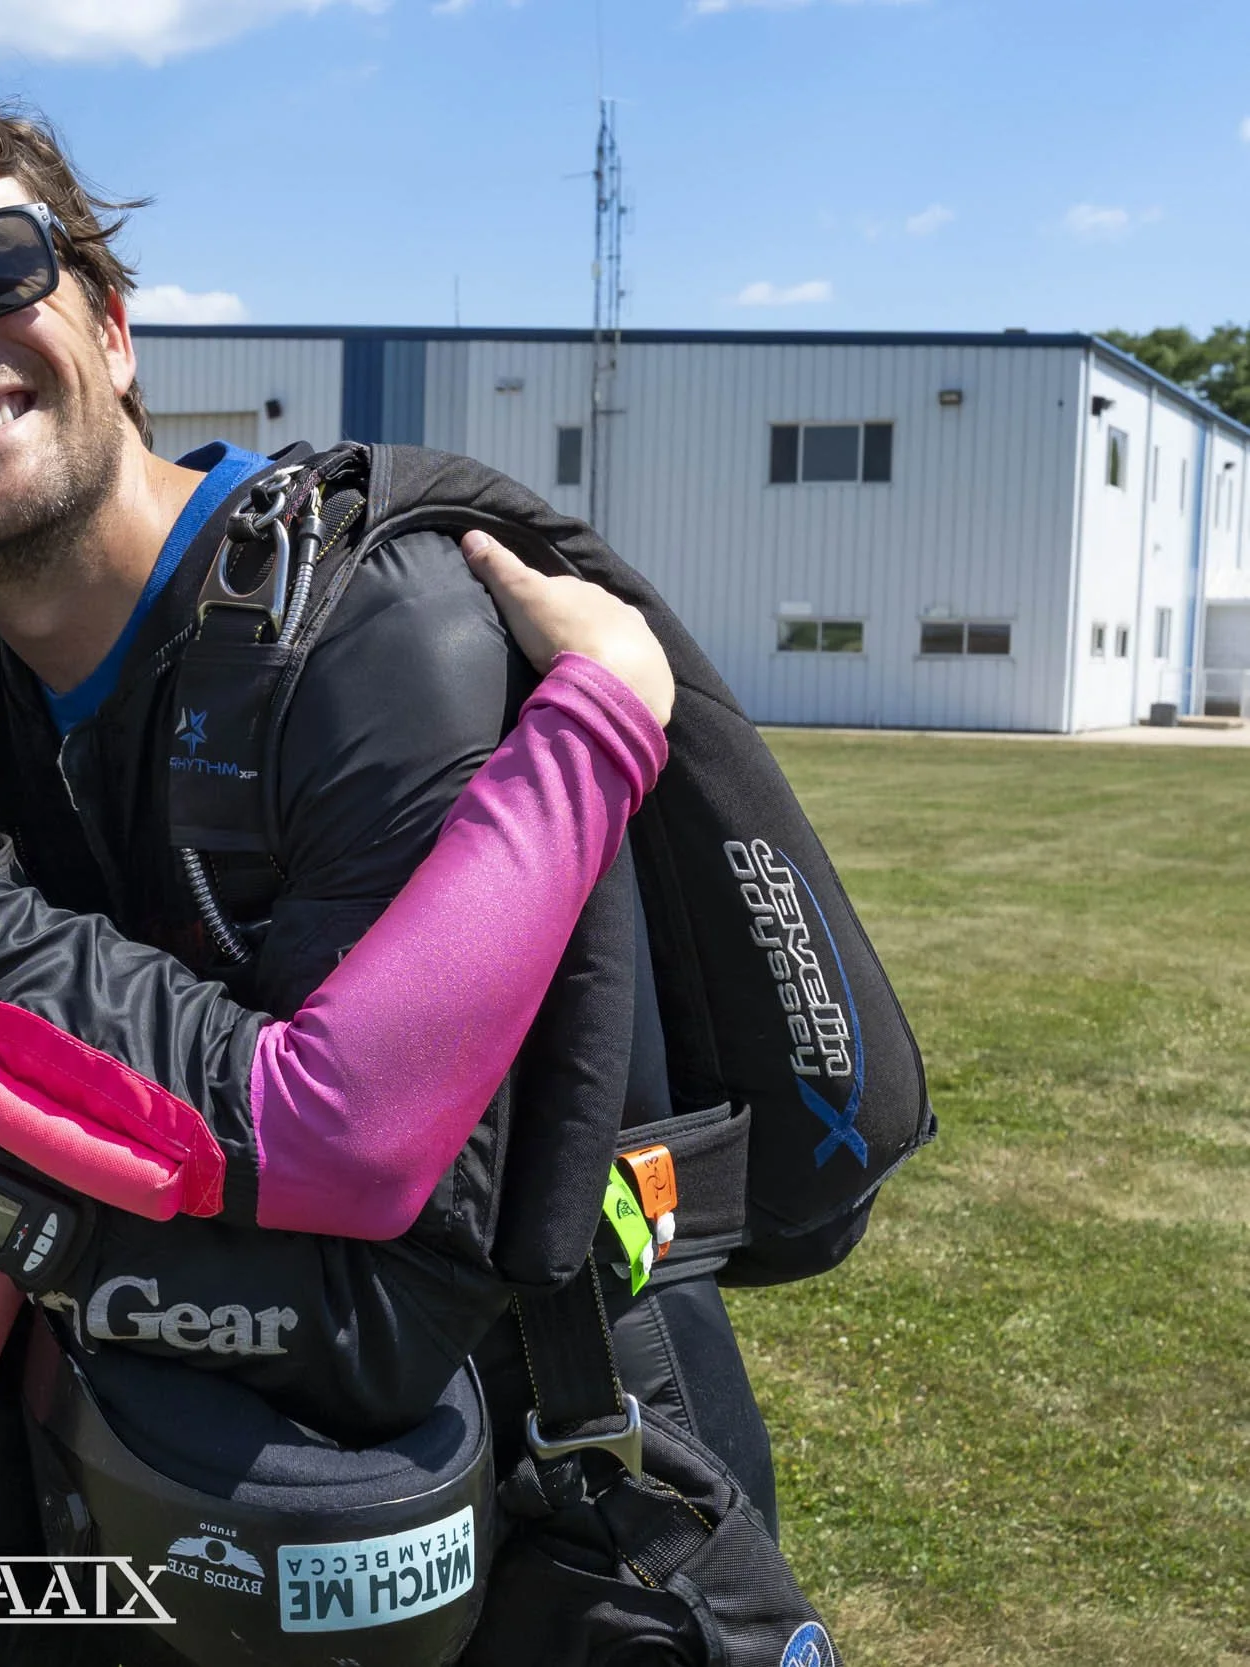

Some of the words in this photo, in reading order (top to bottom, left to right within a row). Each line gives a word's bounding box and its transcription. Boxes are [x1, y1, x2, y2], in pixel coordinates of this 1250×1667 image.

[723, 840, 820, 1077] Odyssey
[750, 838, 851, 1078] Javelin
[86, 1275, 299, 1356] Gear
[199, 1522, 238, 1538] STUDIO
[166, 1558, 199, 1581] EYE
[288, 1578, 354, 1621] ME
[369, 1543, 472, 1614] WATCH
